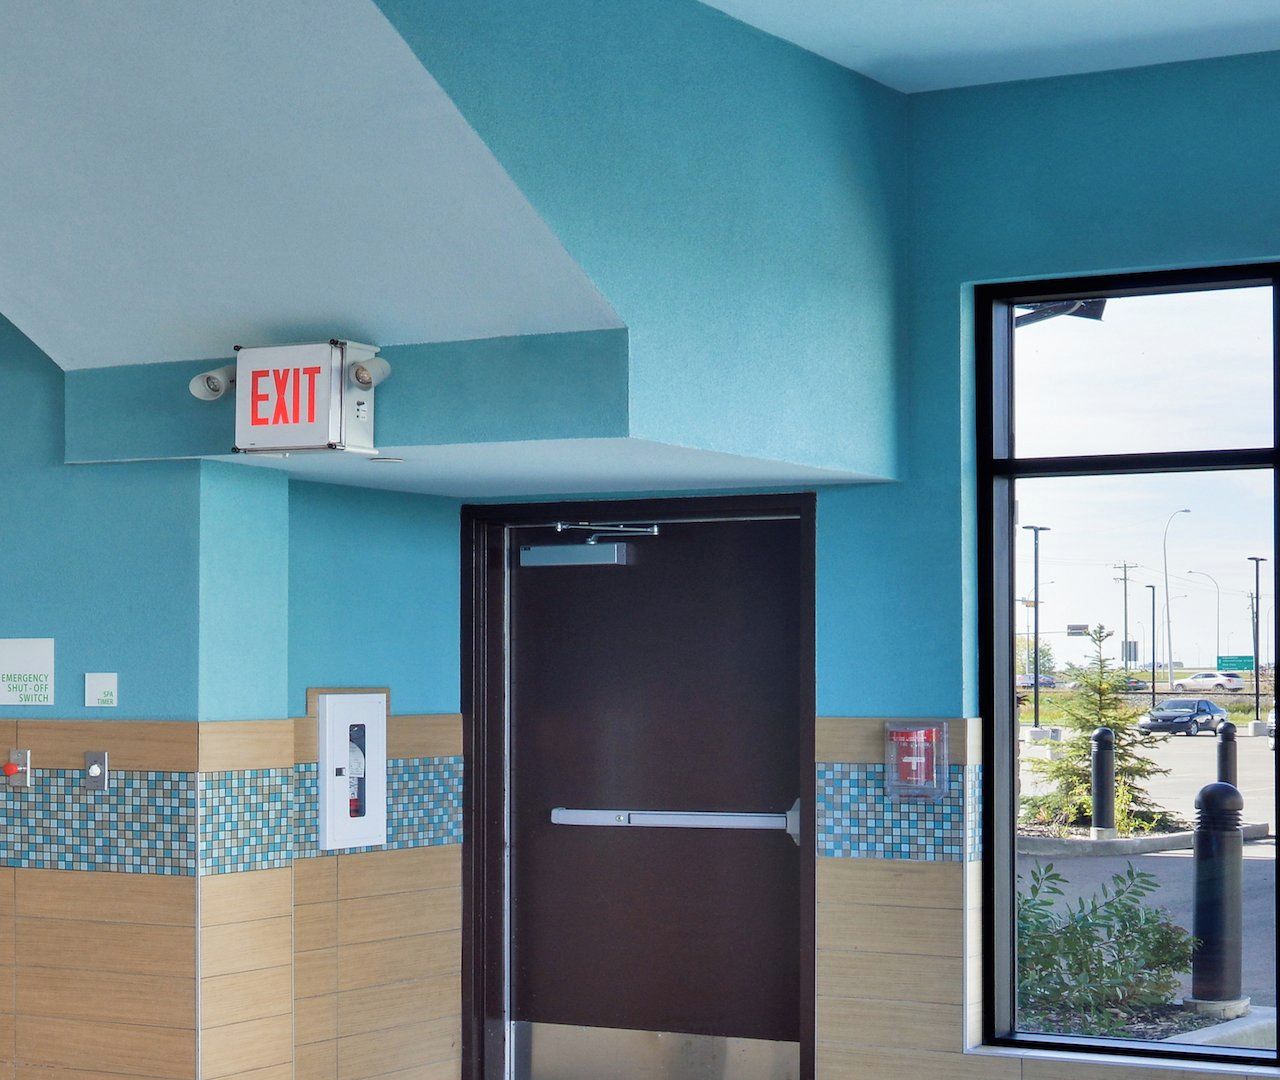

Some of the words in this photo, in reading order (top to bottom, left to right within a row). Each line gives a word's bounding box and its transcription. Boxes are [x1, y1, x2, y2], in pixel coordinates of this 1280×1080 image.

[251, 366, 321, 426] EXIT
[1, 673, 49, 683] EMERGENCY
[18, 693, 49, 703] SWITCH
